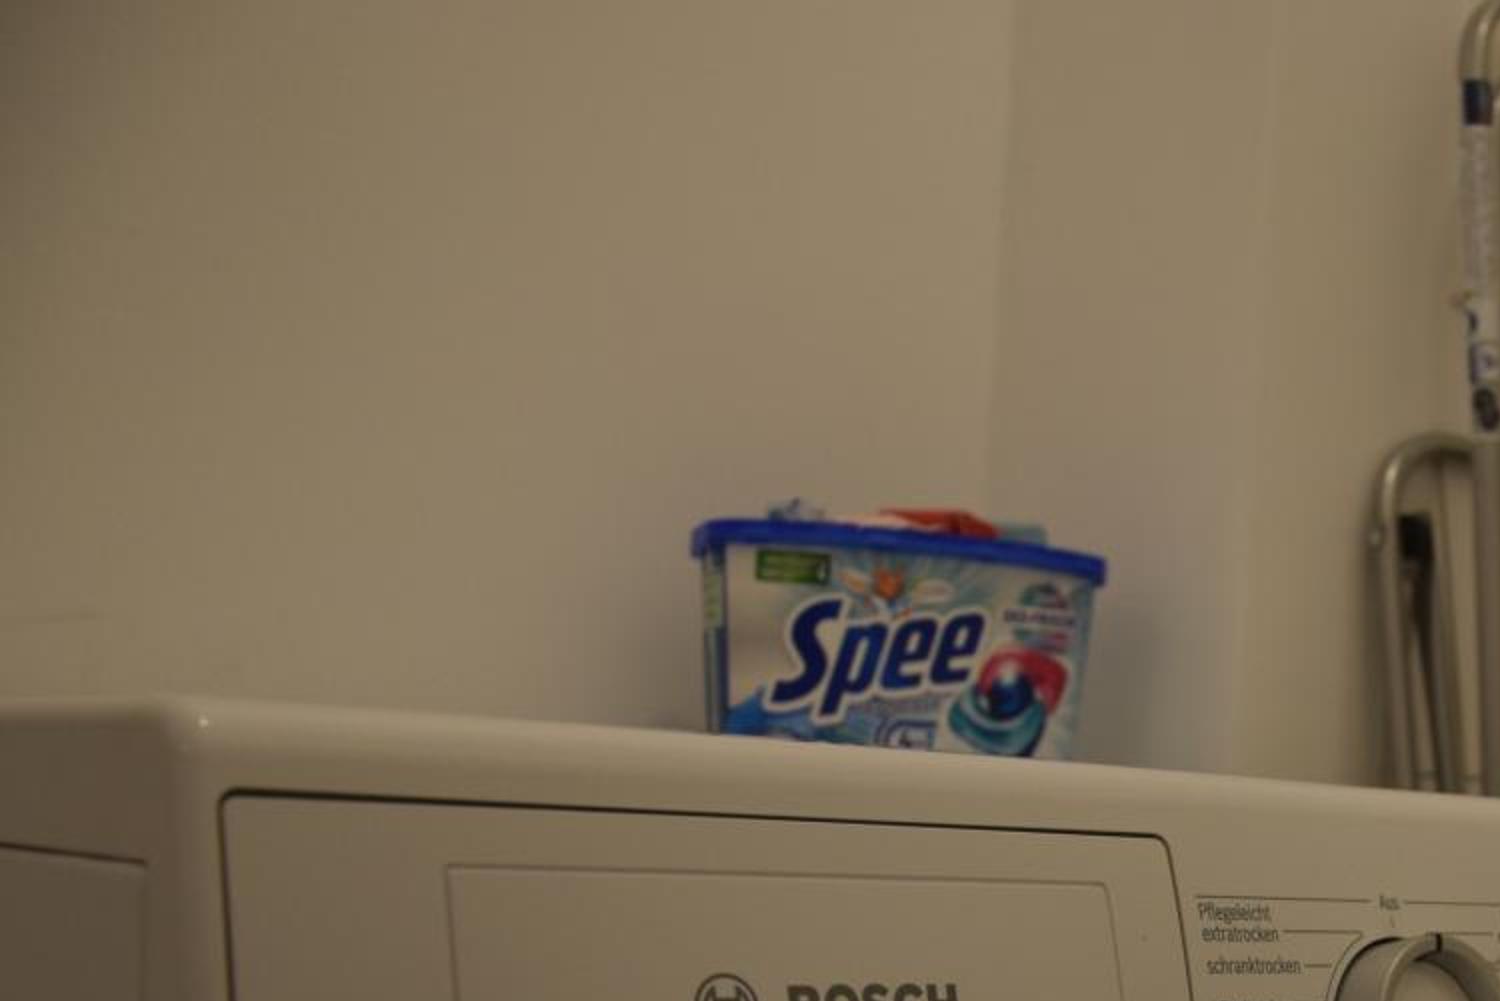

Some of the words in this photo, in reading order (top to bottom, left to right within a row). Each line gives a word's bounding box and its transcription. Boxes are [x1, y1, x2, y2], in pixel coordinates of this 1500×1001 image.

[772, 600, 984, 717] Spee
[1201, 927, 1279, 942] extratrocken
[1206, 954, 1301, 974] schranktrocken
